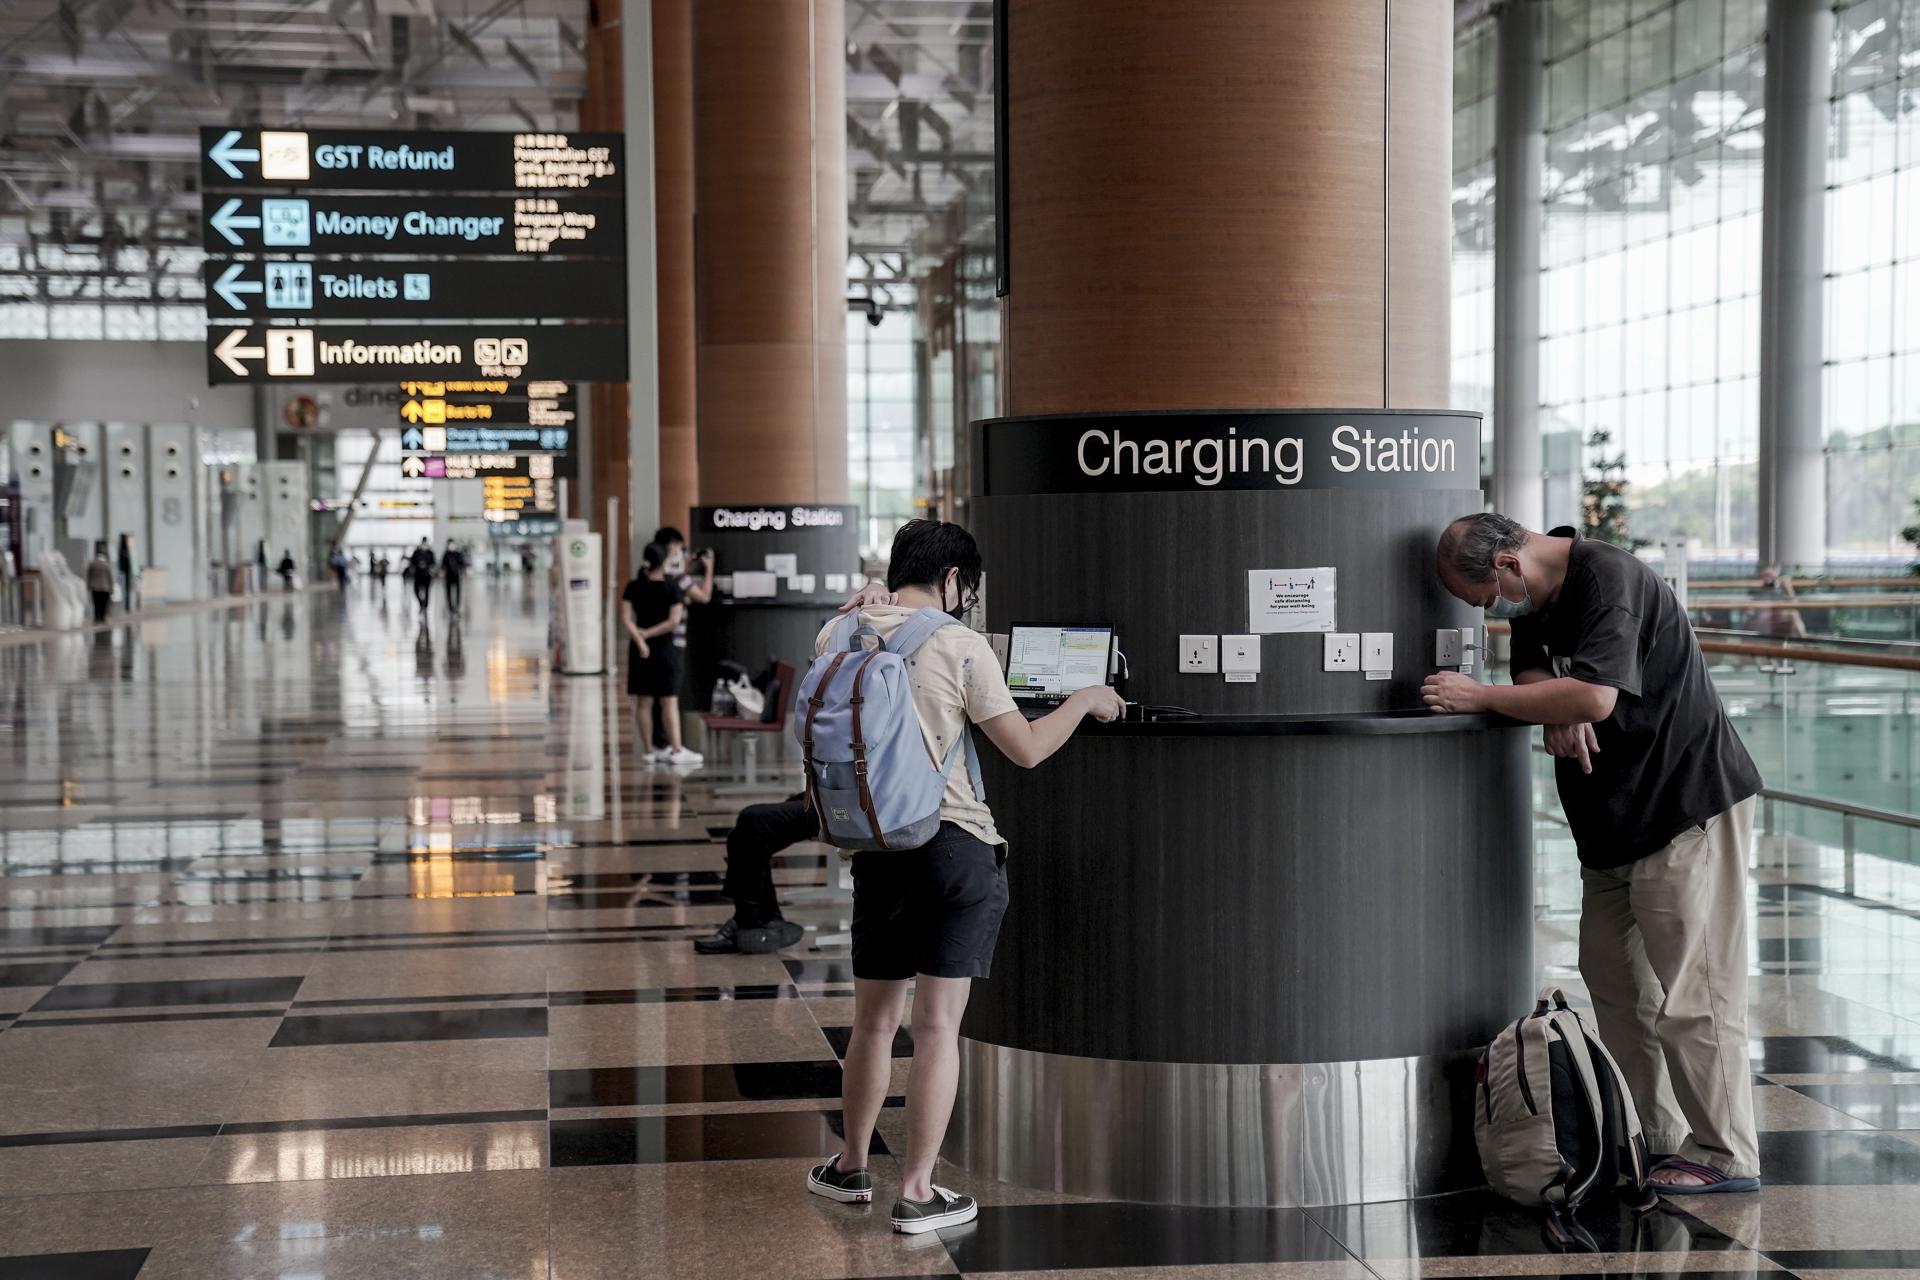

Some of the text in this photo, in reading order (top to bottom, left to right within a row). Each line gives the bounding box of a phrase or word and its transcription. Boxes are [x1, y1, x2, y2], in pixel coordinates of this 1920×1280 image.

[314, 144, 455, 171] GST Refund
[315, 211, 400, 241] Money
[403, 211, 505, 241] Changer
[318, 274, 398, 299] Toilets
[319, 339, 462, 365] Information
[1077, 425, 1456, 486] Charging Station
[713, 507, 843, 531] Charging Station
